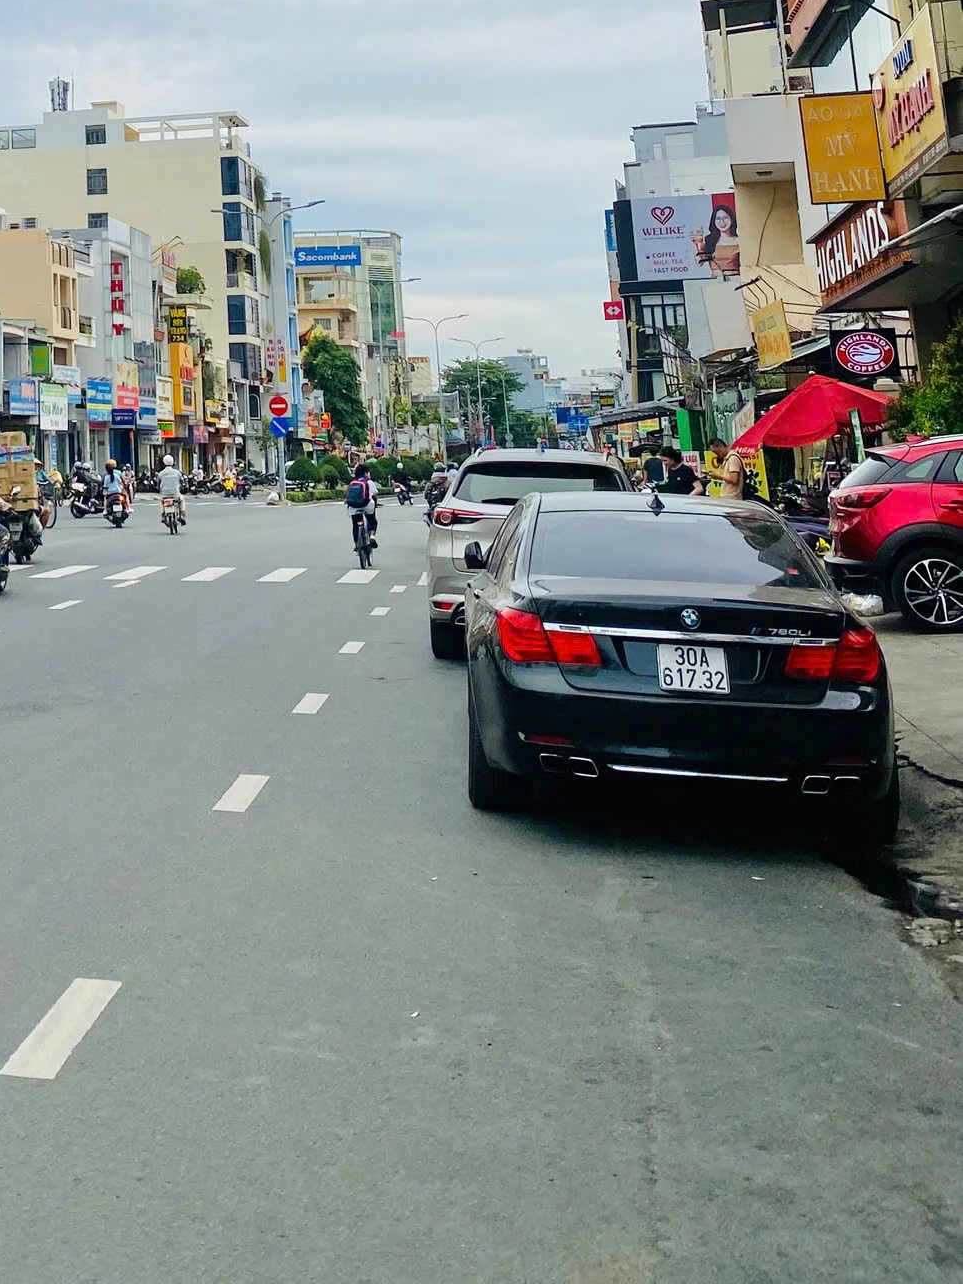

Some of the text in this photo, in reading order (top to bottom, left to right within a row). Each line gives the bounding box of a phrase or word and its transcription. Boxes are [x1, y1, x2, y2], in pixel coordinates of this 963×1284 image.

[642, 226, 684, 236] WELIKE
[816, 201, 889, 291] HIGHLANDS
[297, 251, 358, 262] Sacombank
[652, 251, 676, 259] COFFEE
[839, 334, 891, 352] HIGHLANDS
[847, 361, 887, 372] COFFEE
[674, 646, 710, 668] 30A
[662, 667, 726, 691] 617.32
